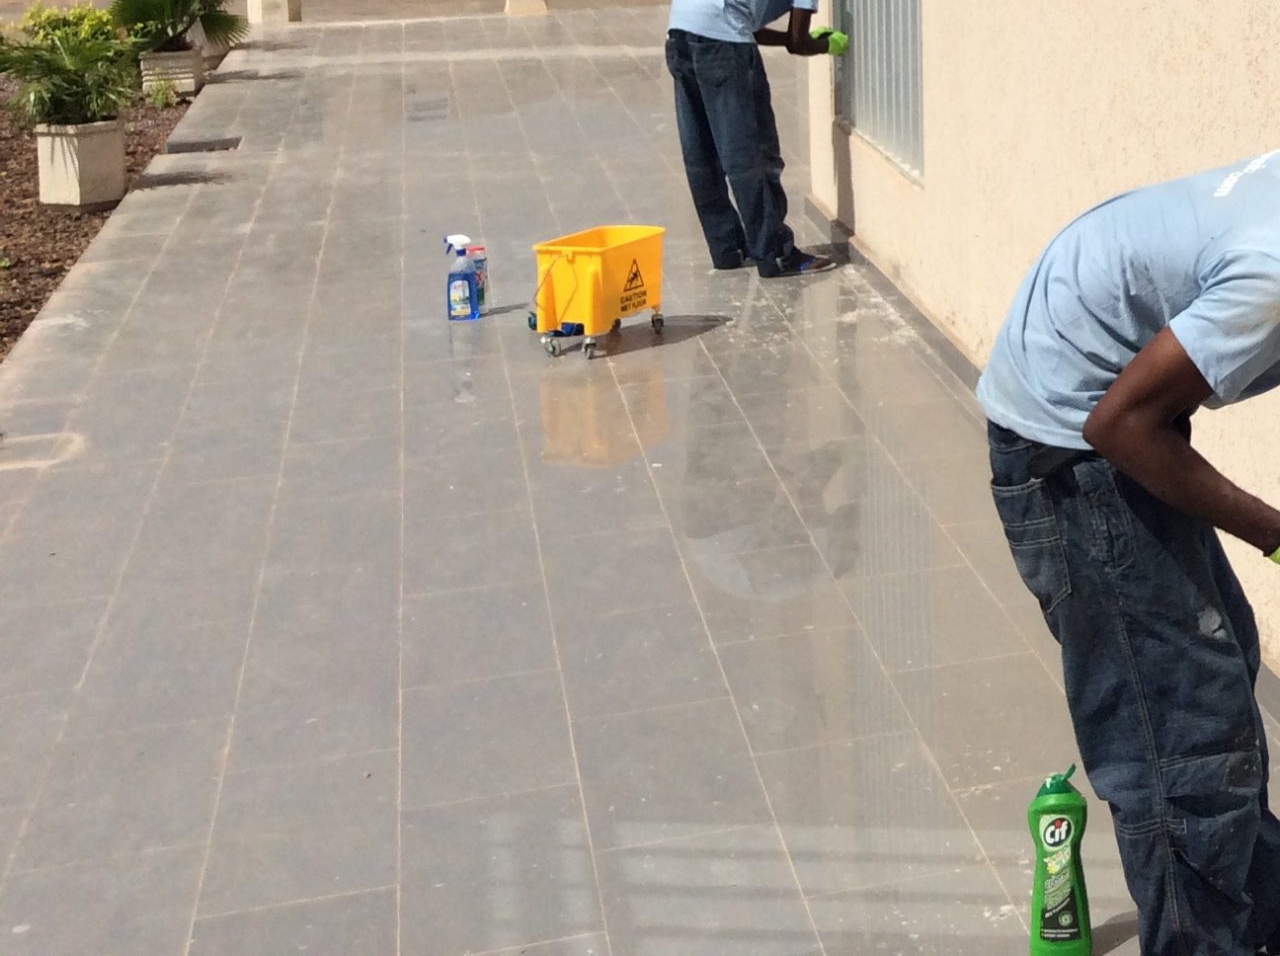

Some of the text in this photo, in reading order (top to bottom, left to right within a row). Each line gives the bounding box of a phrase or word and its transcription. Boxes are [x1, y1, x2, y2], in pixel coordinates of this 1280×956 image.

[620, 290, 647, 305] CAUTION
[620, 303, 631, 313] WET
[1045, 819, 1069, 844] Cif
